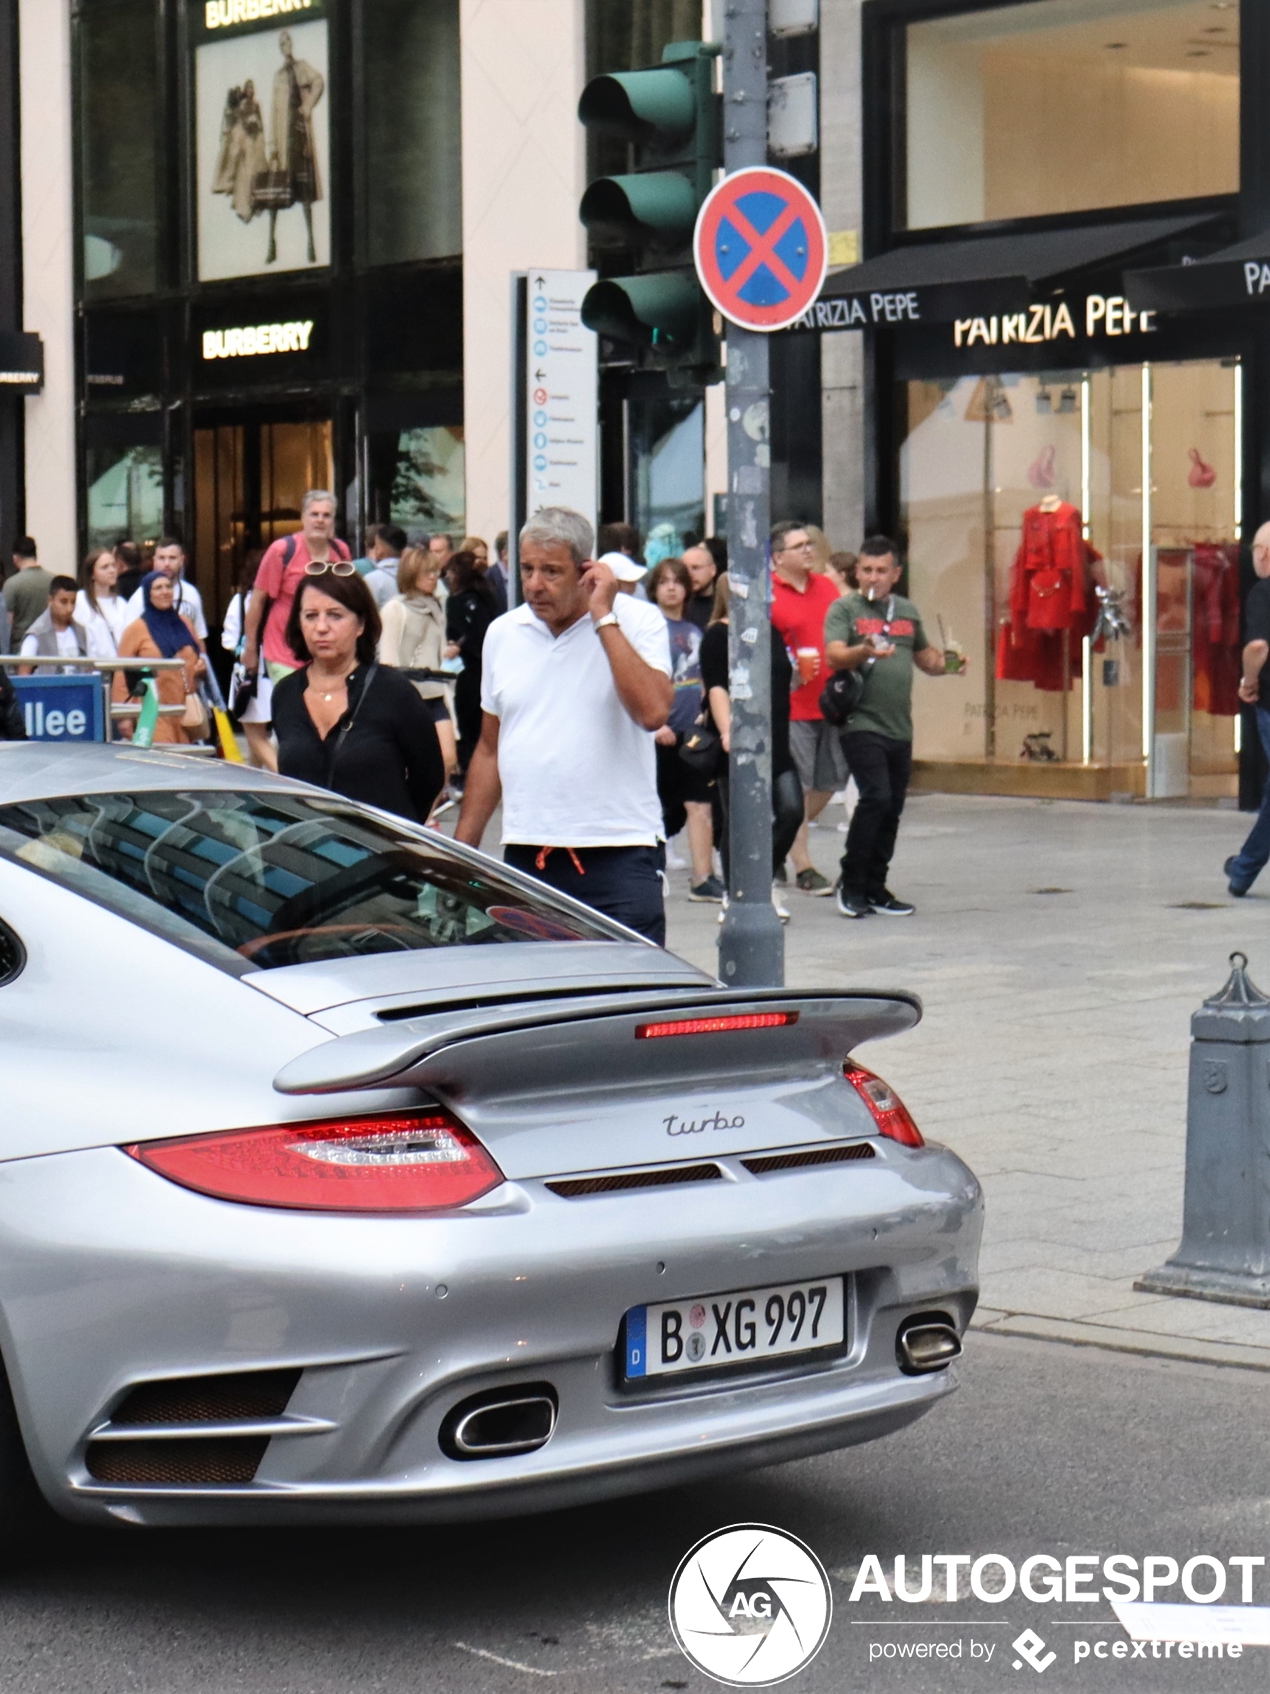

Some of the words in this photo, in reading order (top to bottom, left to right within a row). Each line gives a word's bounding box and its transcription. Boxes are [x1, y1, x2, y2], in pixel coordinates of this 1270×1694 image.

[787, 298, 867, 330] ATRIZIA
[870, 292, 920, 322] PEPE
[202, 321, 313, 360] BURBERRY
[663, 1110, 745, 1136] turbo
[661, 1311, 683, 1364] B
[710, 1298, 756, 1356] XG
[764, 1286, 827, 1347] 997
[632, 1350, 640, 1365] D
